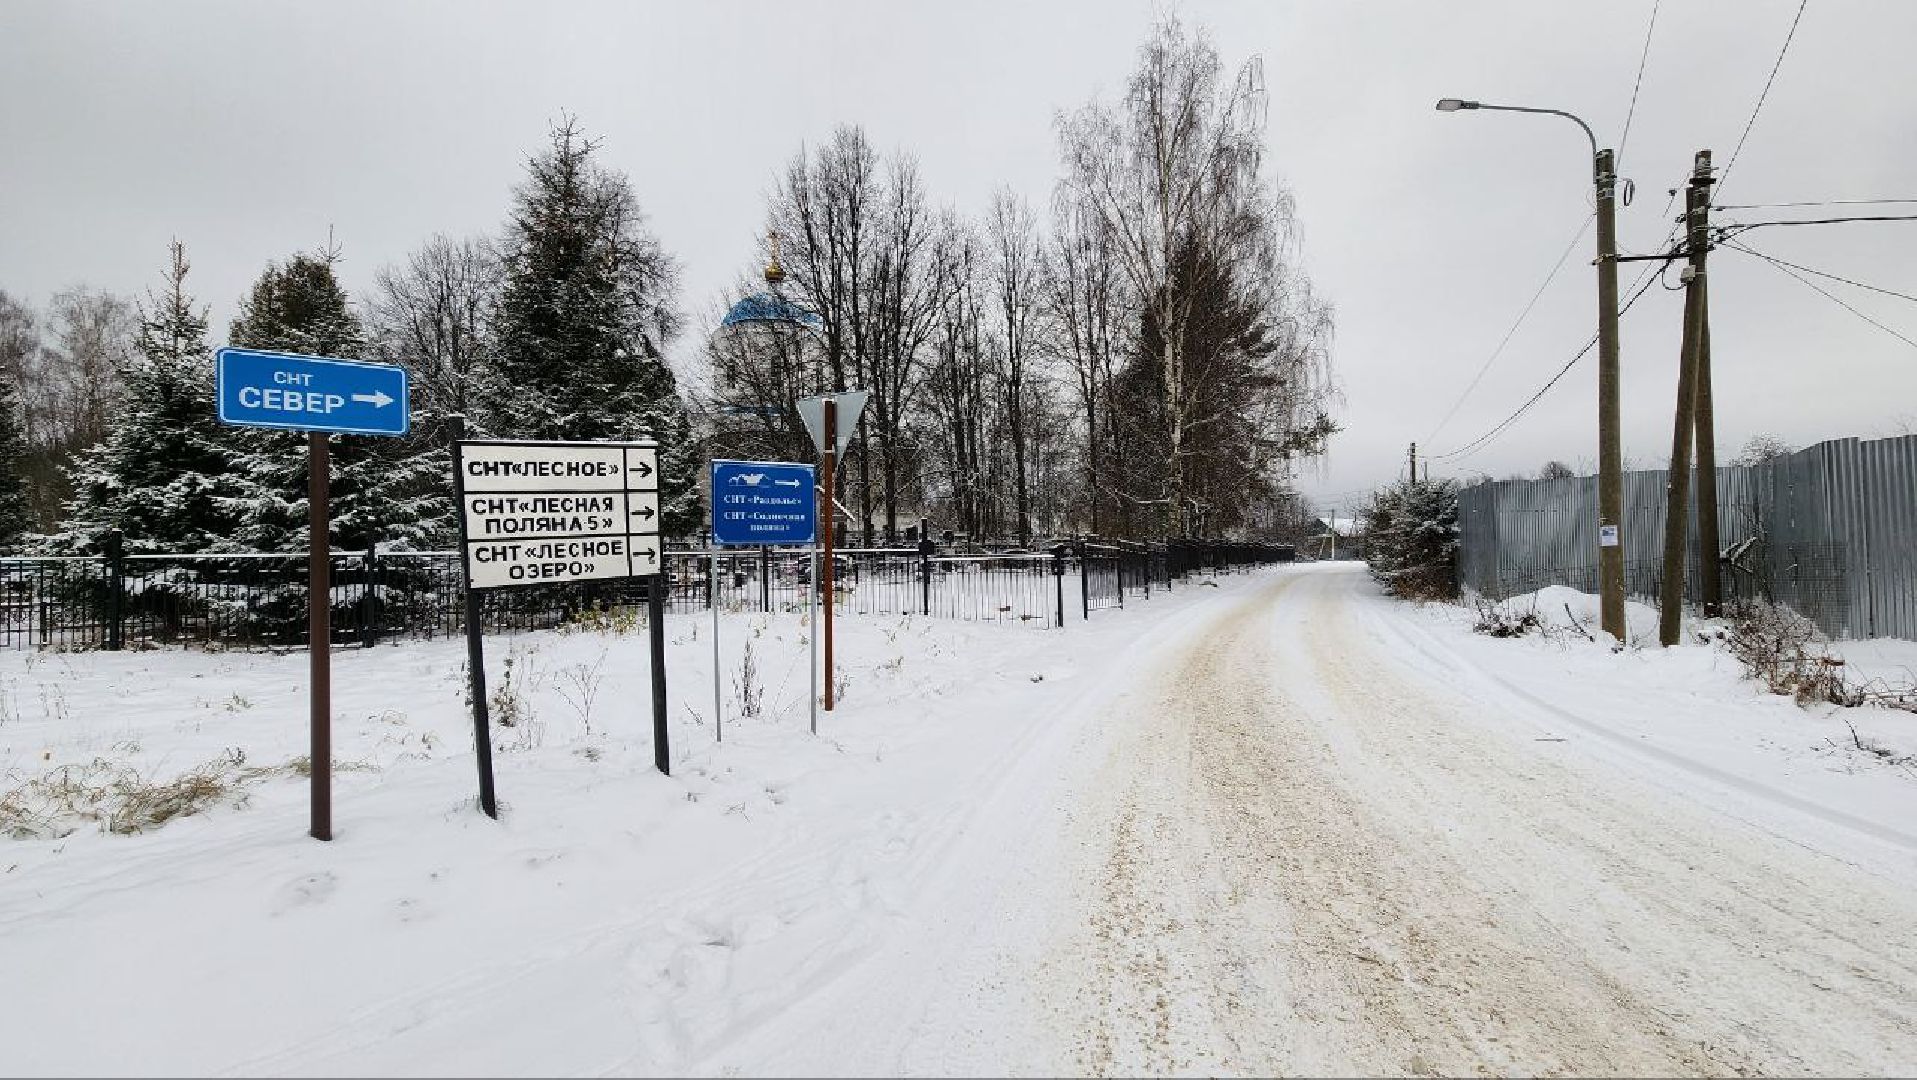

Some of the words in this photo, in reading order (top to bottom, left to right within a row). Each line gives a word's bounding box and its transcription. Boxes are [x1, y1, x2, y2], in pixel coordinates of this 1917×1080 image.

[273, 371, 314, 387] СНТ
[238, 386, 345, 414] СЕВЕР
[723, 494, 746, 504] СНТ
[723, 511, 746, 520] СНТ
[475, 545, 522, 562] СНТ
[524, 539, 624, 559] «ЛЕСНОЕ
[508, 561, 595, 580] ОЗЕРО»
